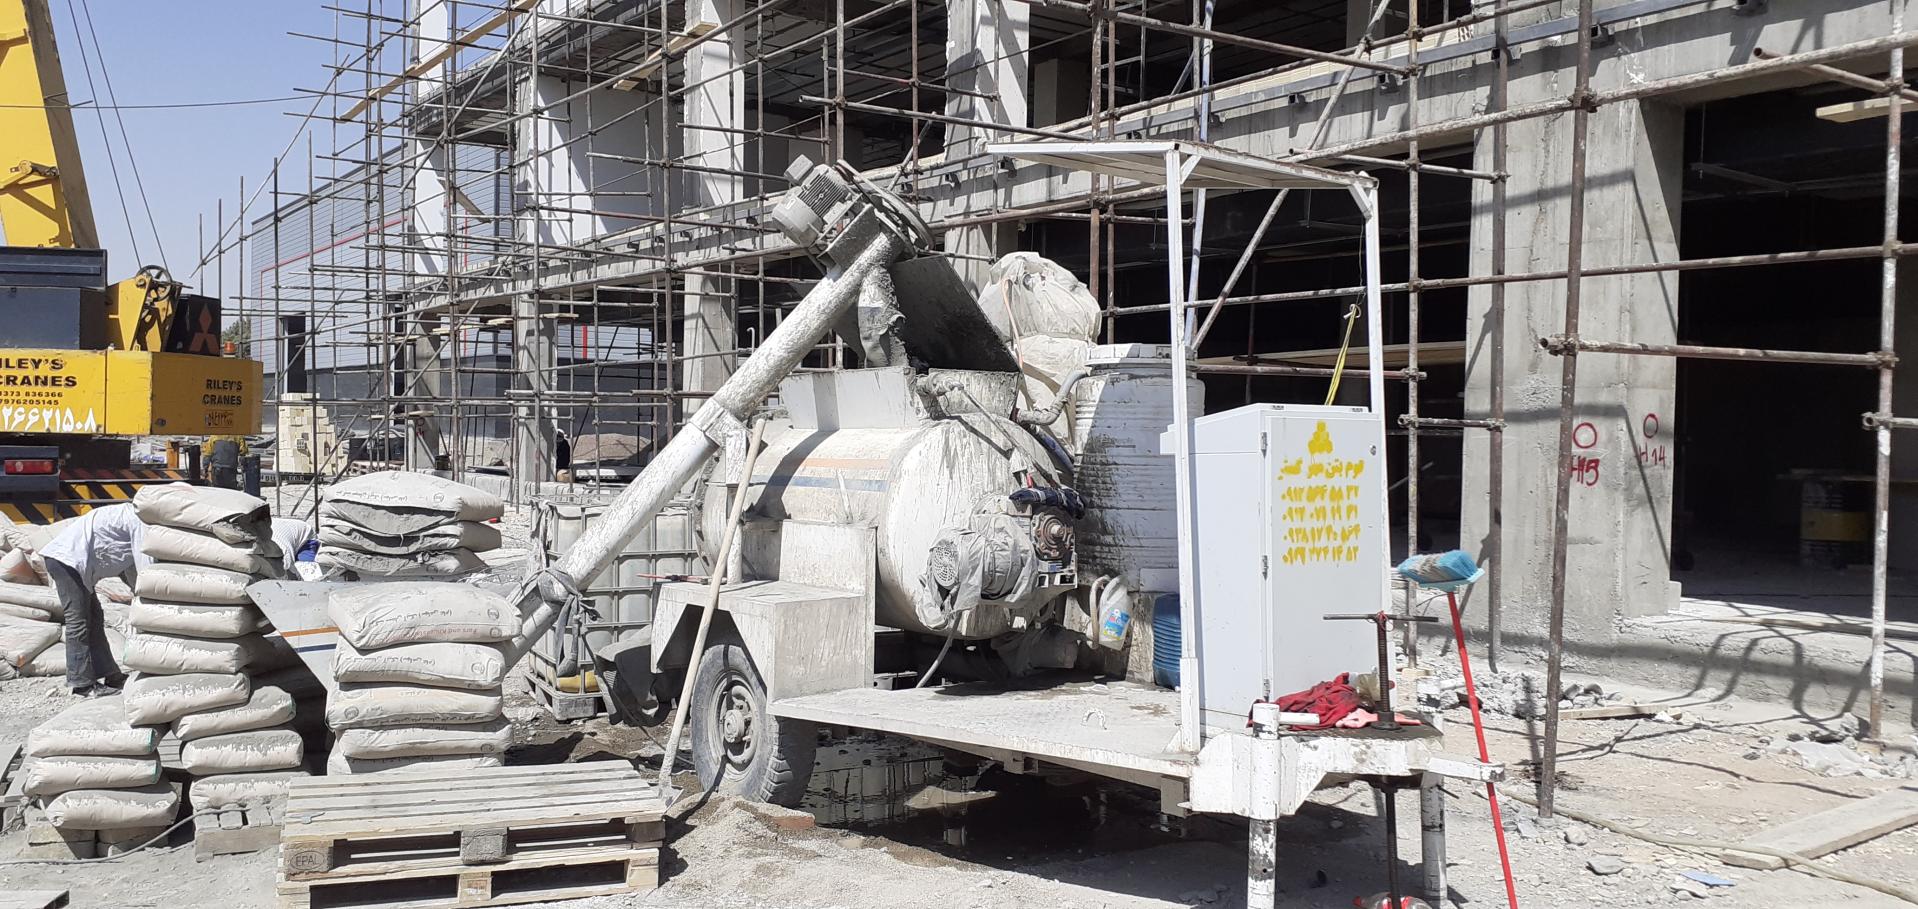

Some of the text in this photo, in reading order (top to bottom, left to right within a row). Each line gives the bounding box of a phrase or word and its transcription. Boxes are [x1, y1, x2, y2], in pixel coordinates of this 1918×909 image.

[0, 375, 77, 387] RANES
[206, 379, 242, 391] RILEY'S
[203, 394, 242, 405] CRANES
